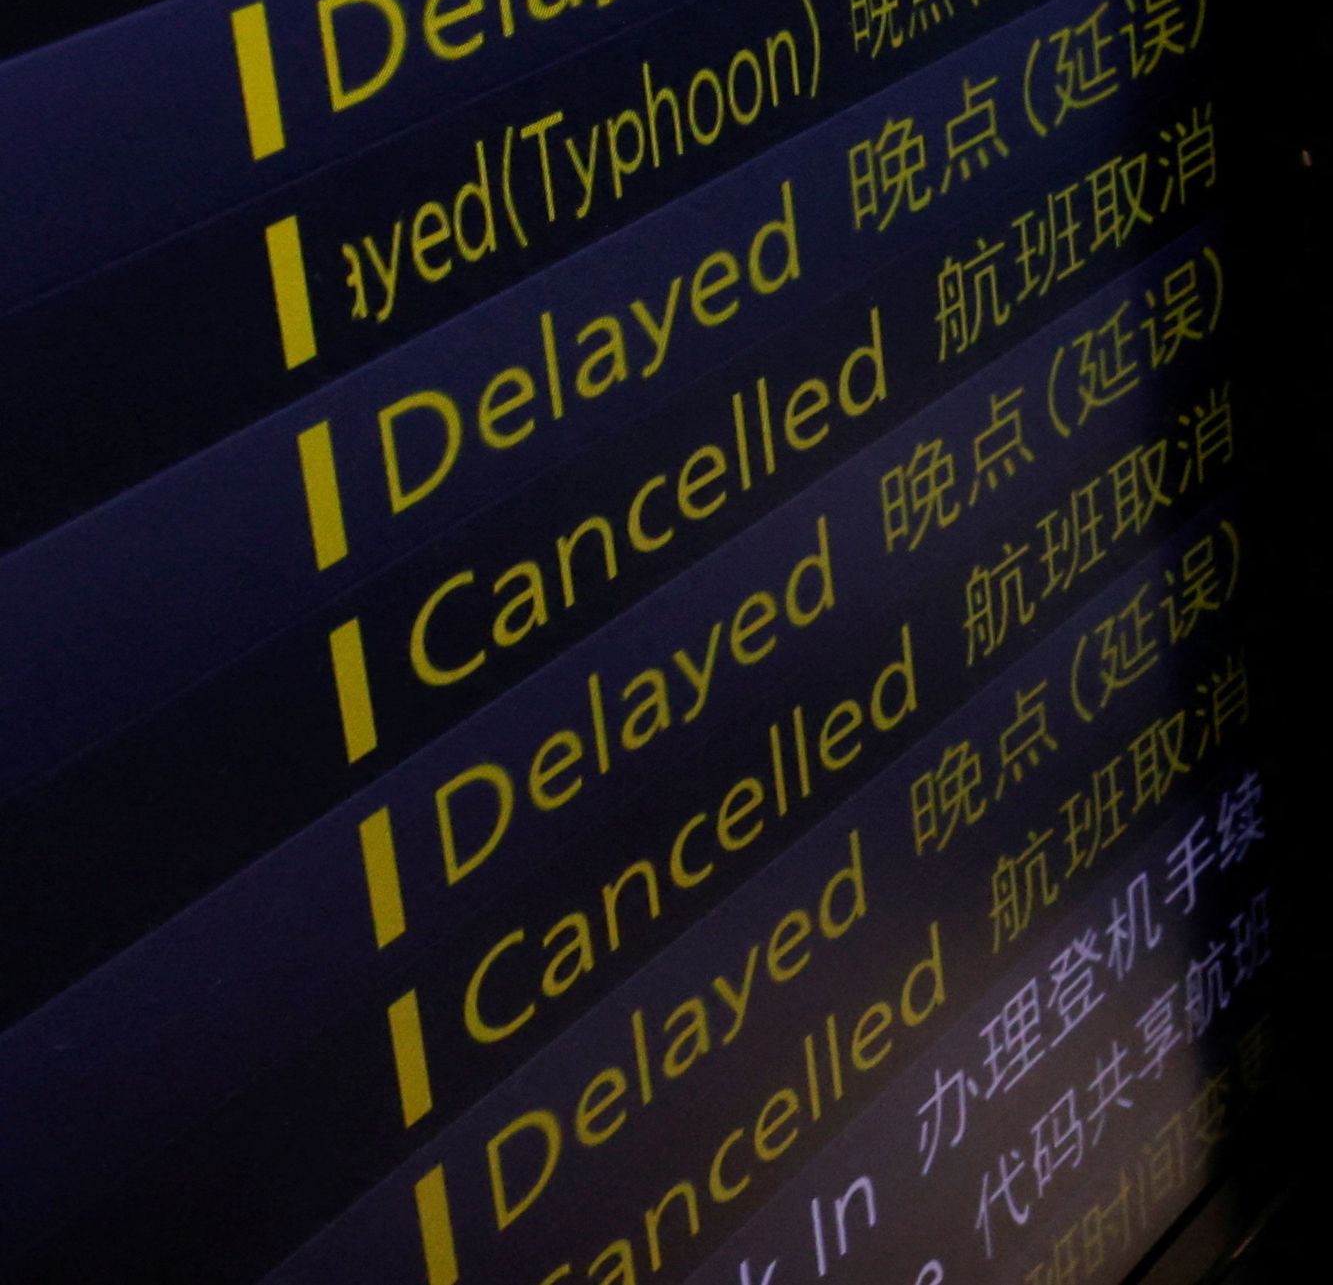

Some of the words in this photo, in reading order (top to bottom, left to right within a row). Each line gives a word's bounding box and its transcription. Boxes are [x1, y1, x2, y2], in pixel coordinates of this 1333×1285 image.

[379, 182, 801, 515] Delayed
[411, 309, 888, 687] Cancelled
[936, 101, 1217, 362] 航班取消
[436, 518, 836, 886] Delayed
[881, 246, 1224, 552] 晚点(延误)
[465, 626, 918, 1044] Cancelled
[963, 376, 1235, 667] 航班取消
[487, 833, 868, 1230] Delayed
[910, 520, 1241, 856] 晚点(延误)
[542, 925, 947, 1285] ancelled
[989, 646, 1248, 954] 航班取消
[811, 1175, 877, 1278] In
[917, 766, 1267, 1177] 办理登机手续
